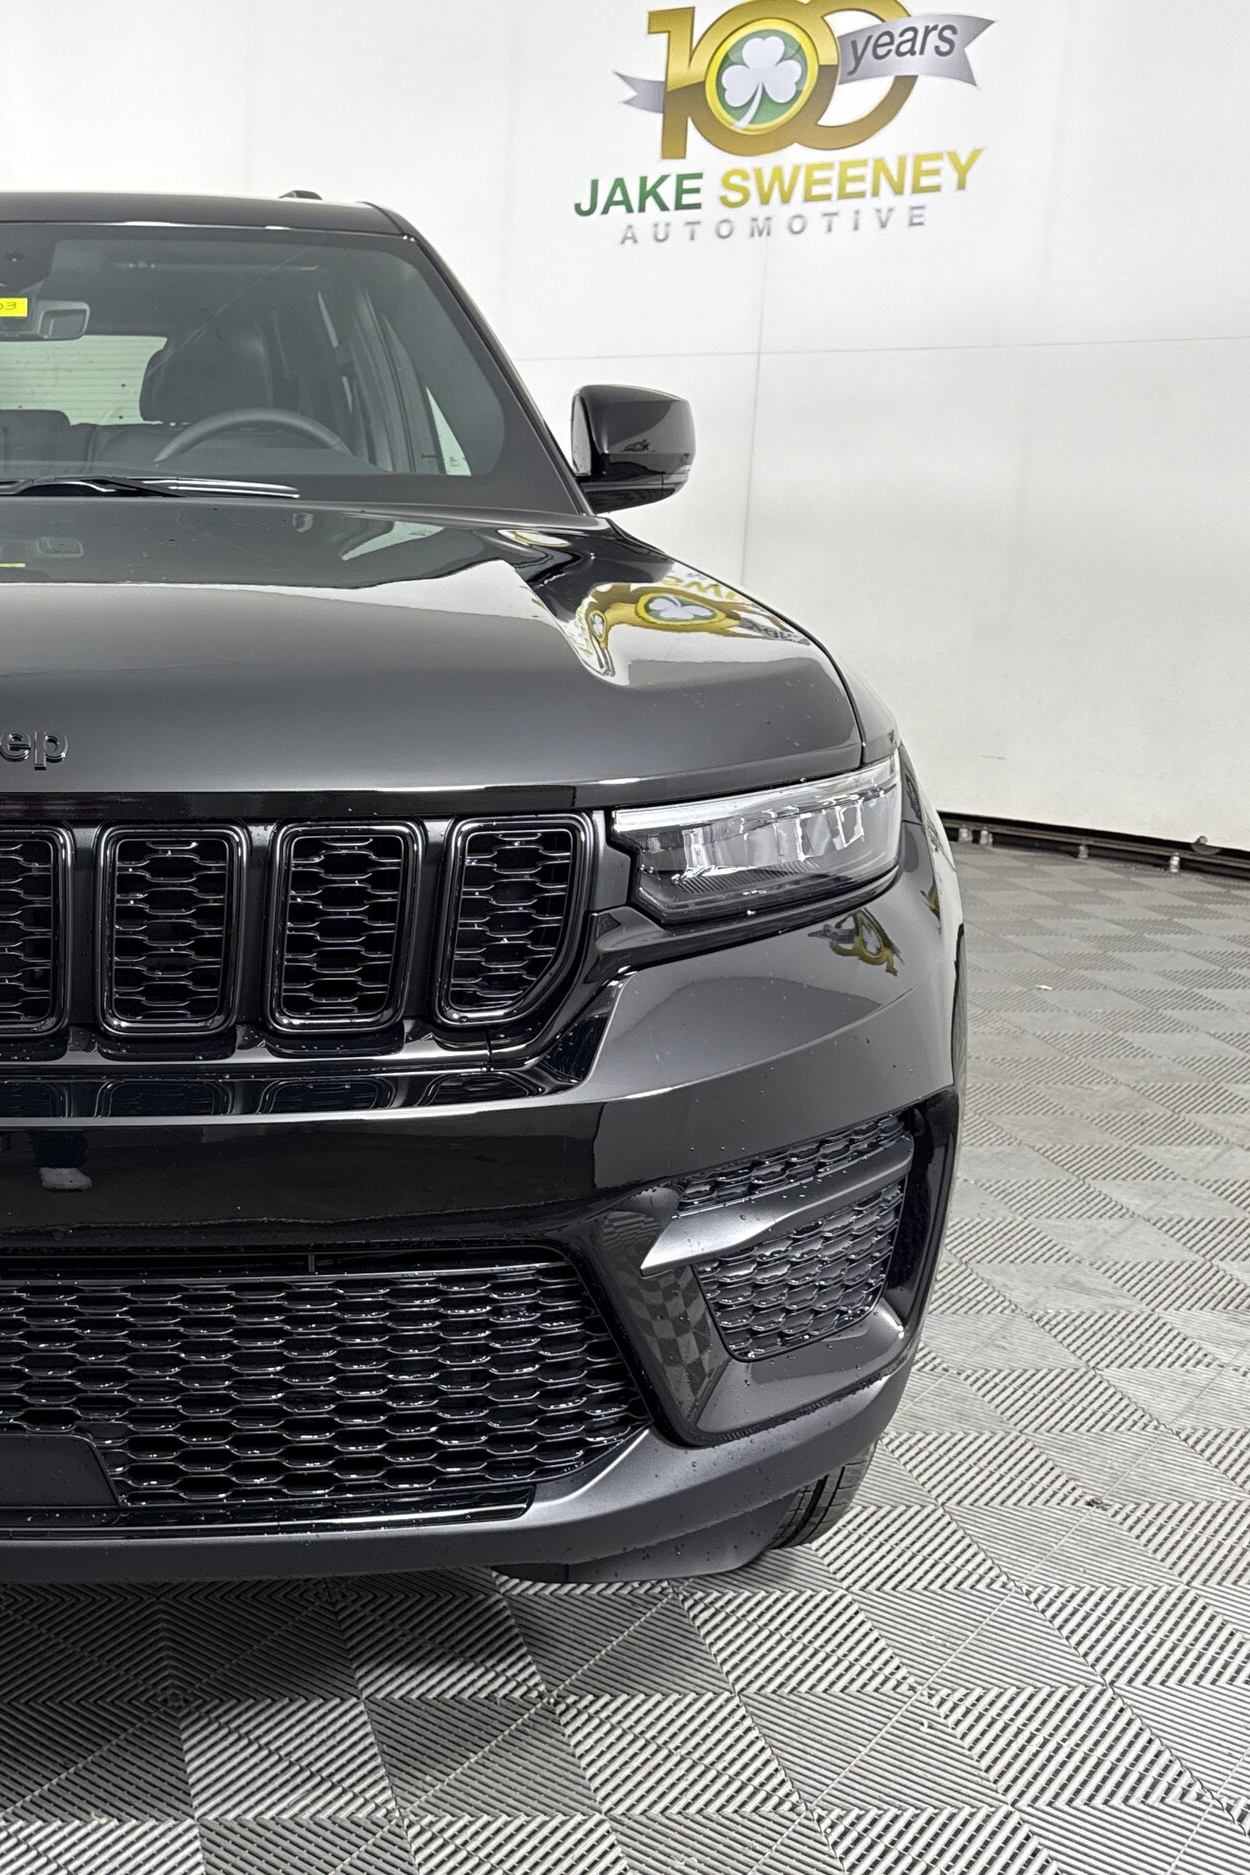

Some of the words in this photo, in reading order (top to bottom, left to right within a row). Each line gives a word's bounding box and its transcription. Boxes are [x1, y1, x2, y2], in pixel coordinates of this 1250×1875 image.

[646, 0, 920, 160] 100
[846, 23, 958, 76] years
[574, 172, 704, 217] JAKE
[719, 148, 982, 209] SWEENEY
[620, 205, 926, 245] AUTOMOTIVE
